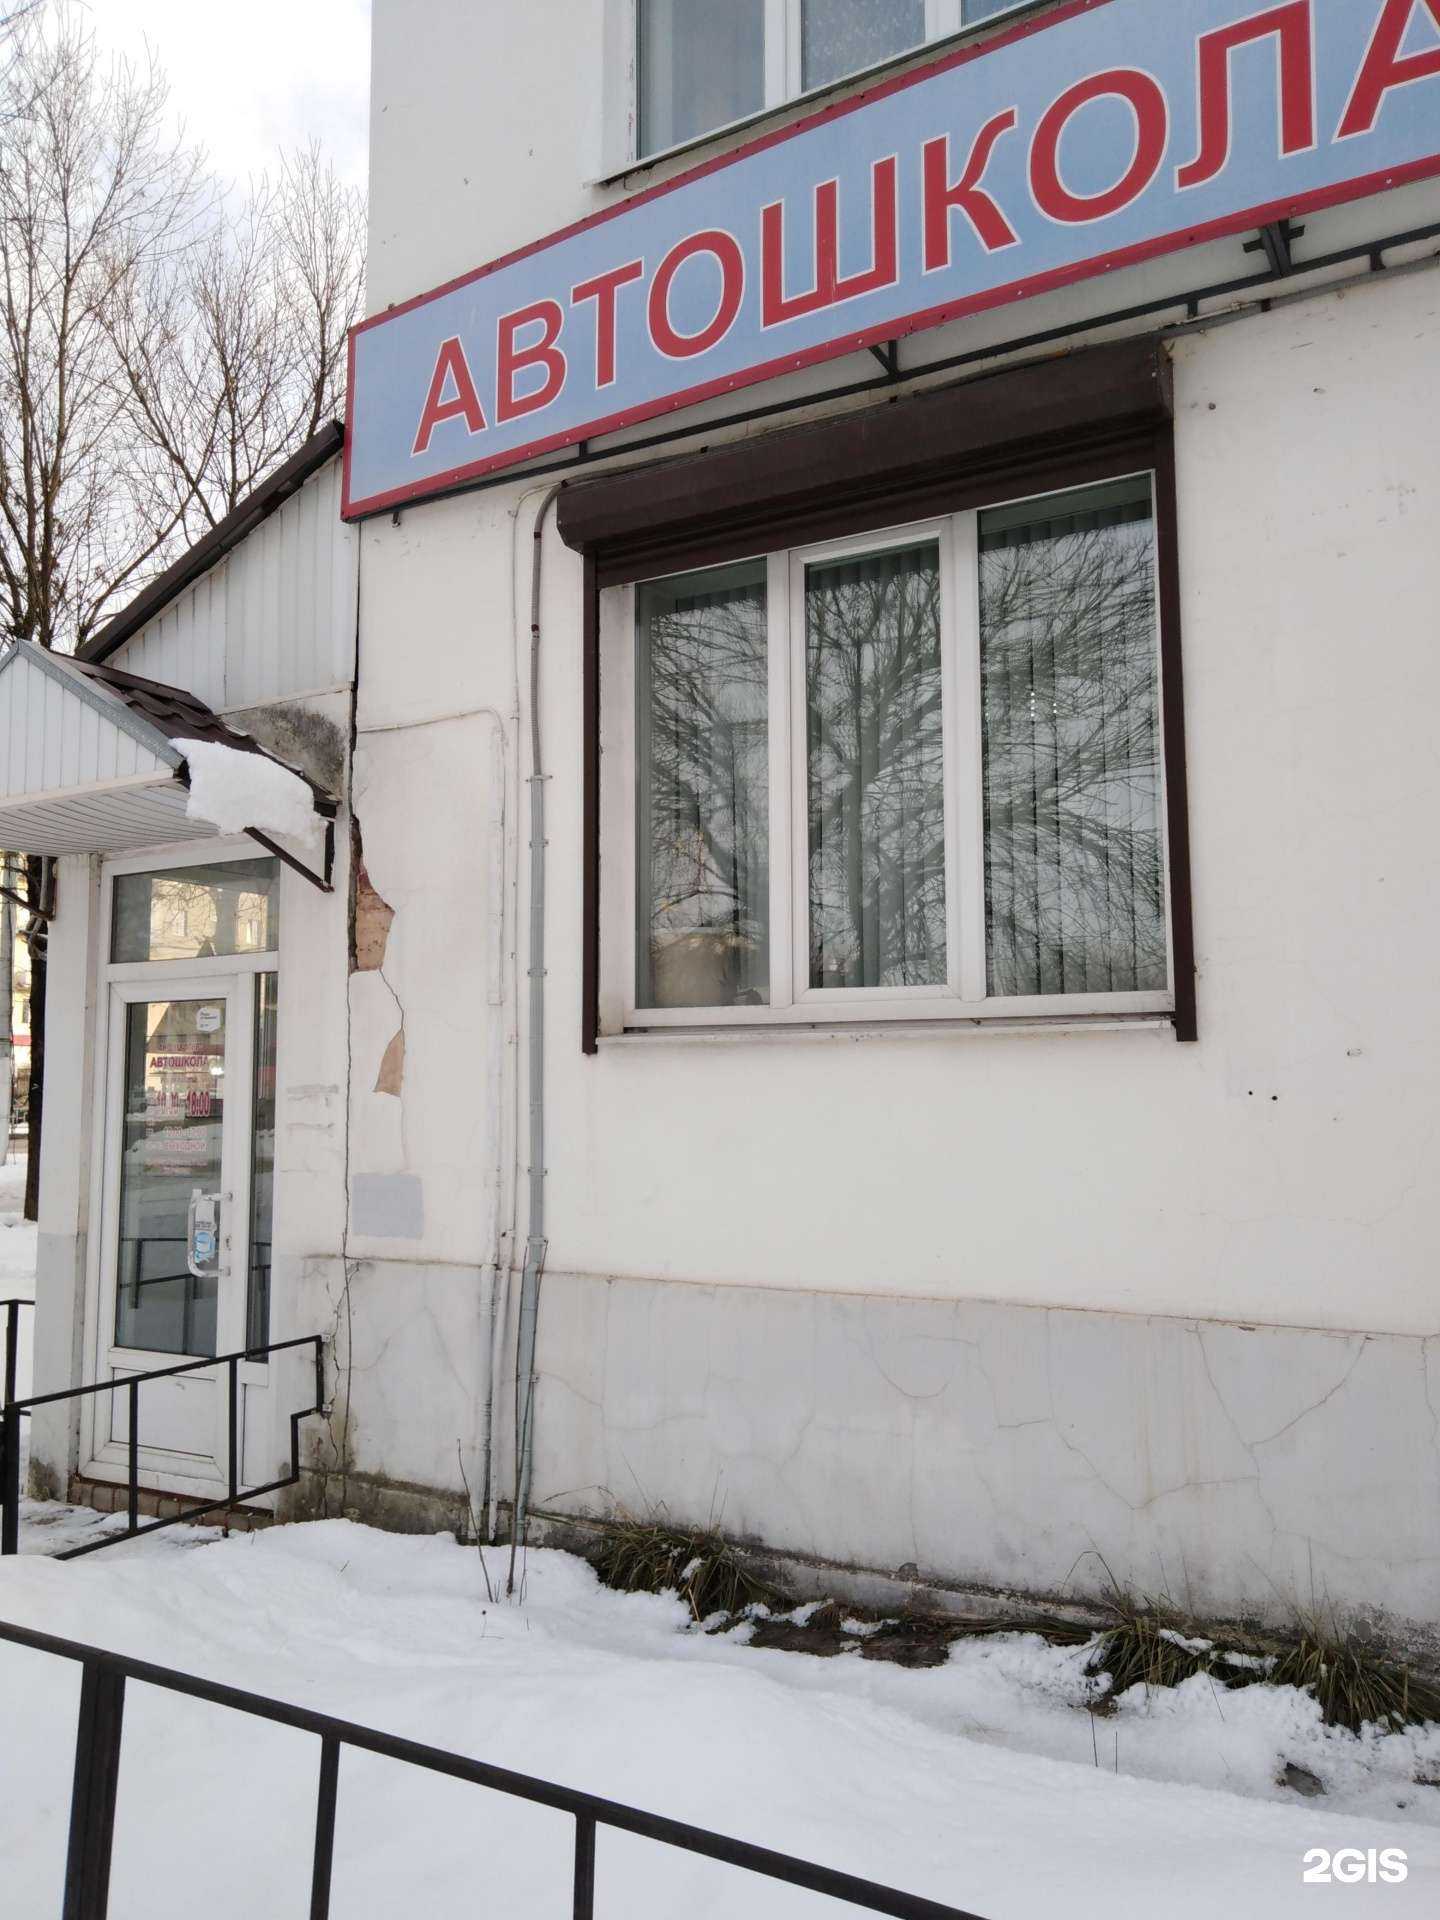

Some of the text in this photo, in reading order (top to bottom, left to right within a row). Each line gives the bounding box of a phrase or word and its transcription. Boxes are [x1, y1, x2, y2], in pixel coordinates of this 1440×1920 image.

[411, 0, 1440, 457] АВТОШКОЛА
[150, 1055, 209, 1069] АВТОШКОЛА
[186, 1090, 210, 1117] 18:00
